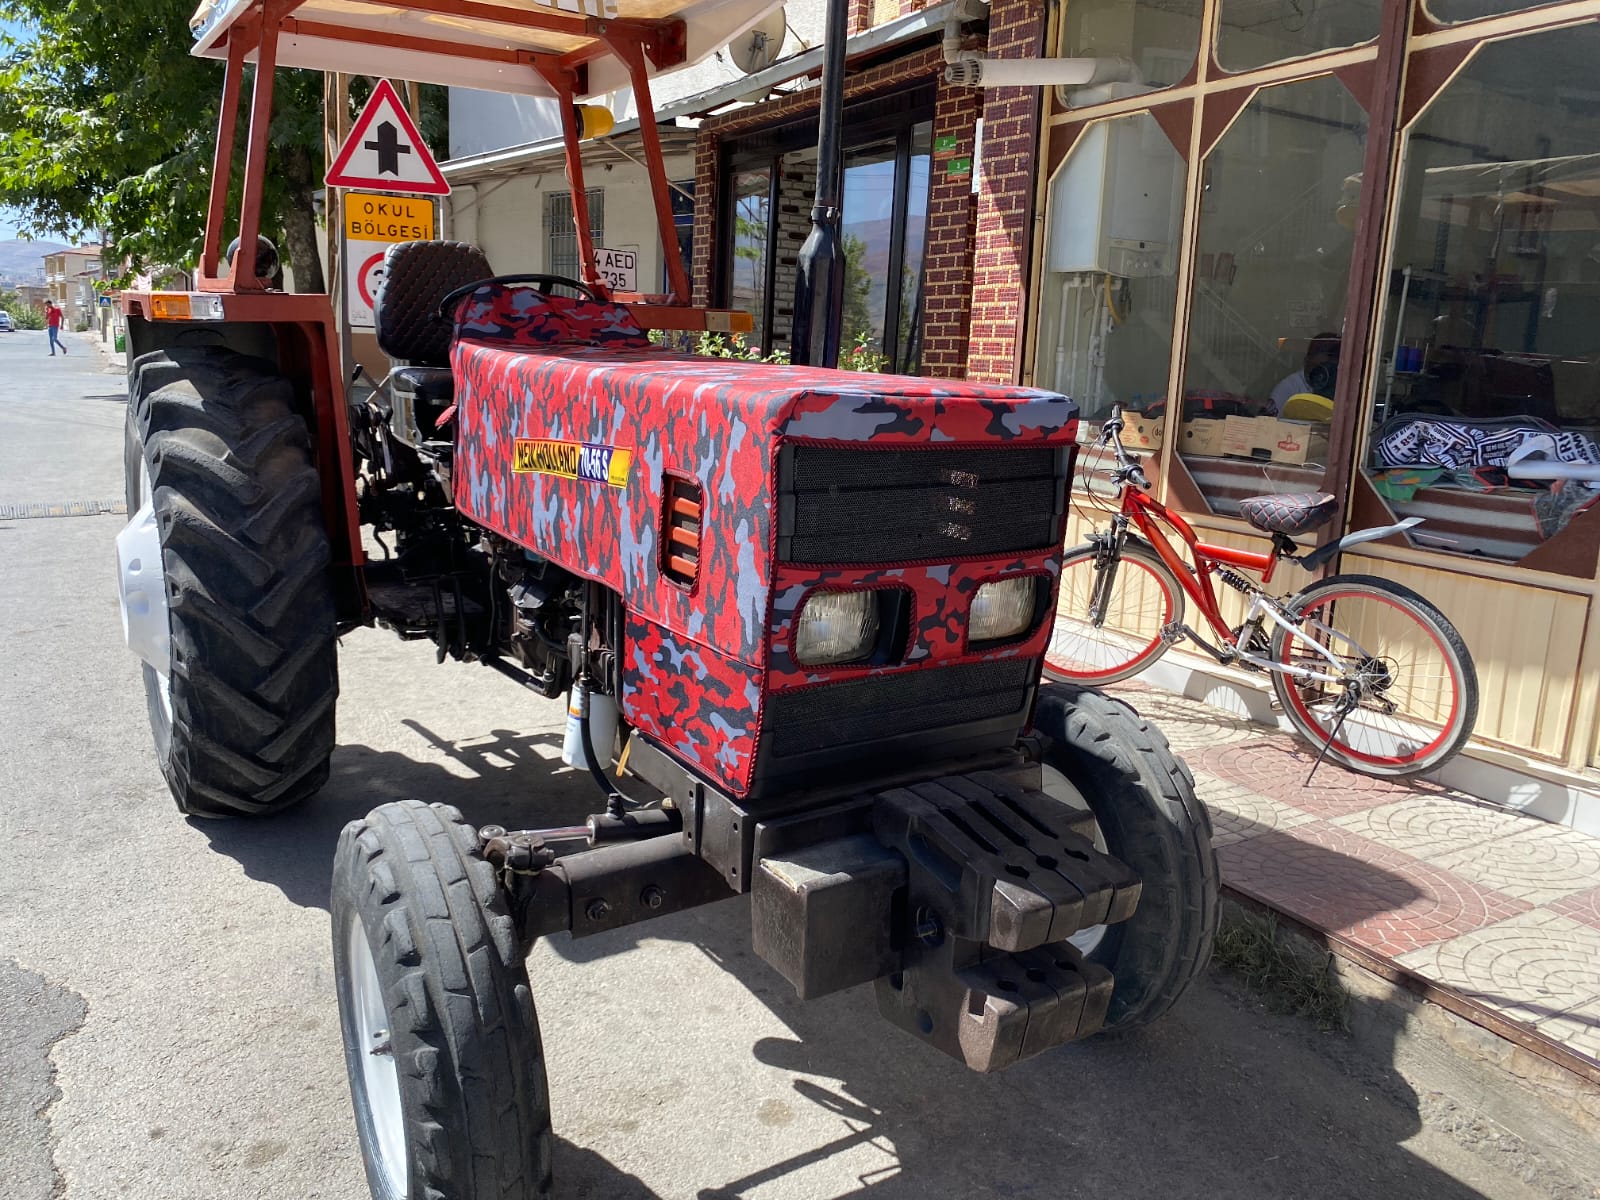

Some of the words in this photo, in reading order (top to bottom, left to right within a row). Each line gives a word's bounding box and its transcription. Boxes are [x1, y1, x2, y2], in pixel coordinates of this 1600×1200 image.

[363, 202, 415, 218] OKUL
[351, 219, 428, 240] BÖLGESİ
[605, 252, 634, 270] AED
[537, 443, 578, 475] HOLLAND
[580, 446, 602, 480] 70-56
[602, 449, 609, 481] S
